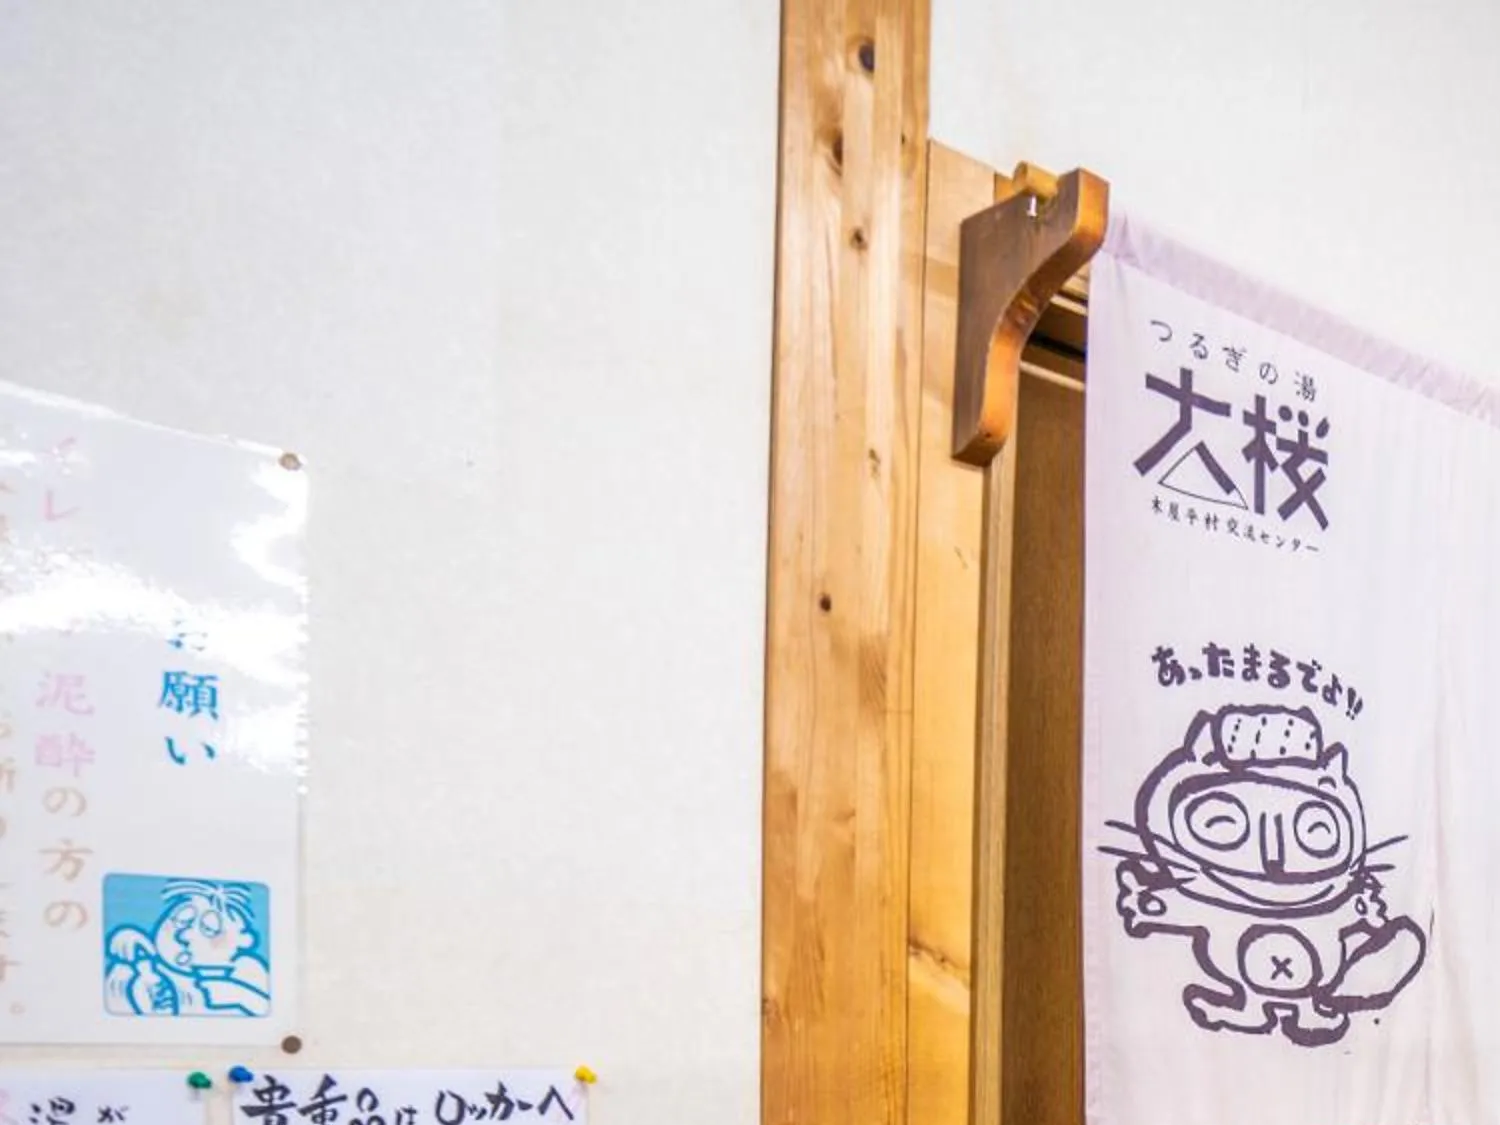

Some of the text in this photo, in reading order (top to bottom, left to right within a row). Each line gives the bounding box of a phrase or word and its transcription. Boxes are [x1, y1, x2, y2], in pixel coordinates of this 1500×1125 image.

[1150, 319, 1317, 402] つるぎの湯
[1134, 367, 1330, 532] 大桜
